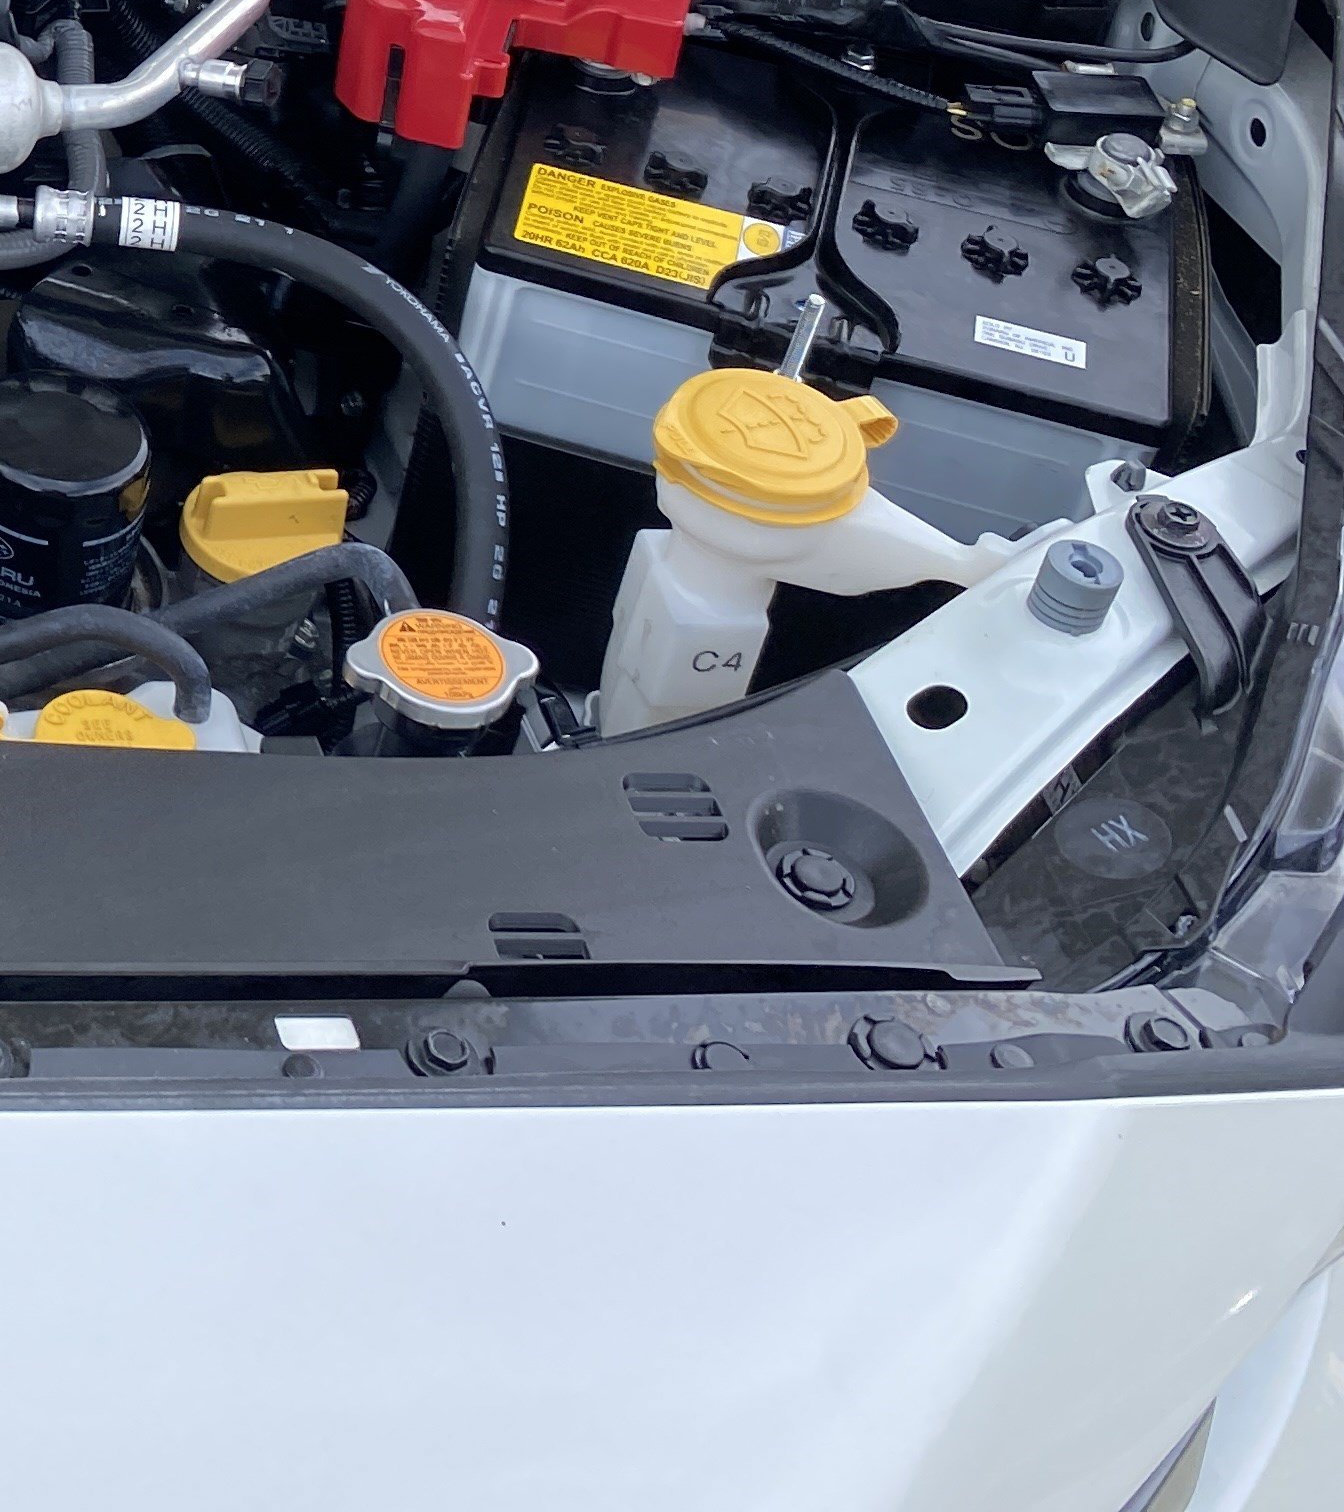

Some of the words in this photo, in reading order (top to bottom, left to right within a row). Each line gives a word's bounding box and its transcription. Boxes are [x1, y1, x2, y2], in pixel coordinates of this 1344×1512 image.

[537, 166, 597, 189] DANGER
[601, 184, 646, 201] EXPLOSIVE
[648, 194, 677, 208] GASES
[133, 202, 145, 215] 2
[154, 204, 169, 218] H
[132, 218, 144, 234] 2
[152, 220, 167, 236] H
[527, 202, 585, 224] POISON
[592, 220, 626, 234] CAUSES
[628, 229, 661, 243] SEVERE
[589, 238, 606, 250] OUT
[608, 242, 620, 253] OF
[591, 248, 618, 263] CCA
[1064, 351, 1076, 363] U
[384, 275, 451, 343] YOKOHAMA
[494, 493, 506, 528] HP
[693, 650, 742, 672] C4
[415, 677, 489, 686] AVERTISSEMENT
[44, 694, 154, 726] COOLANT
[1090, 815, 1150, 853] HX
